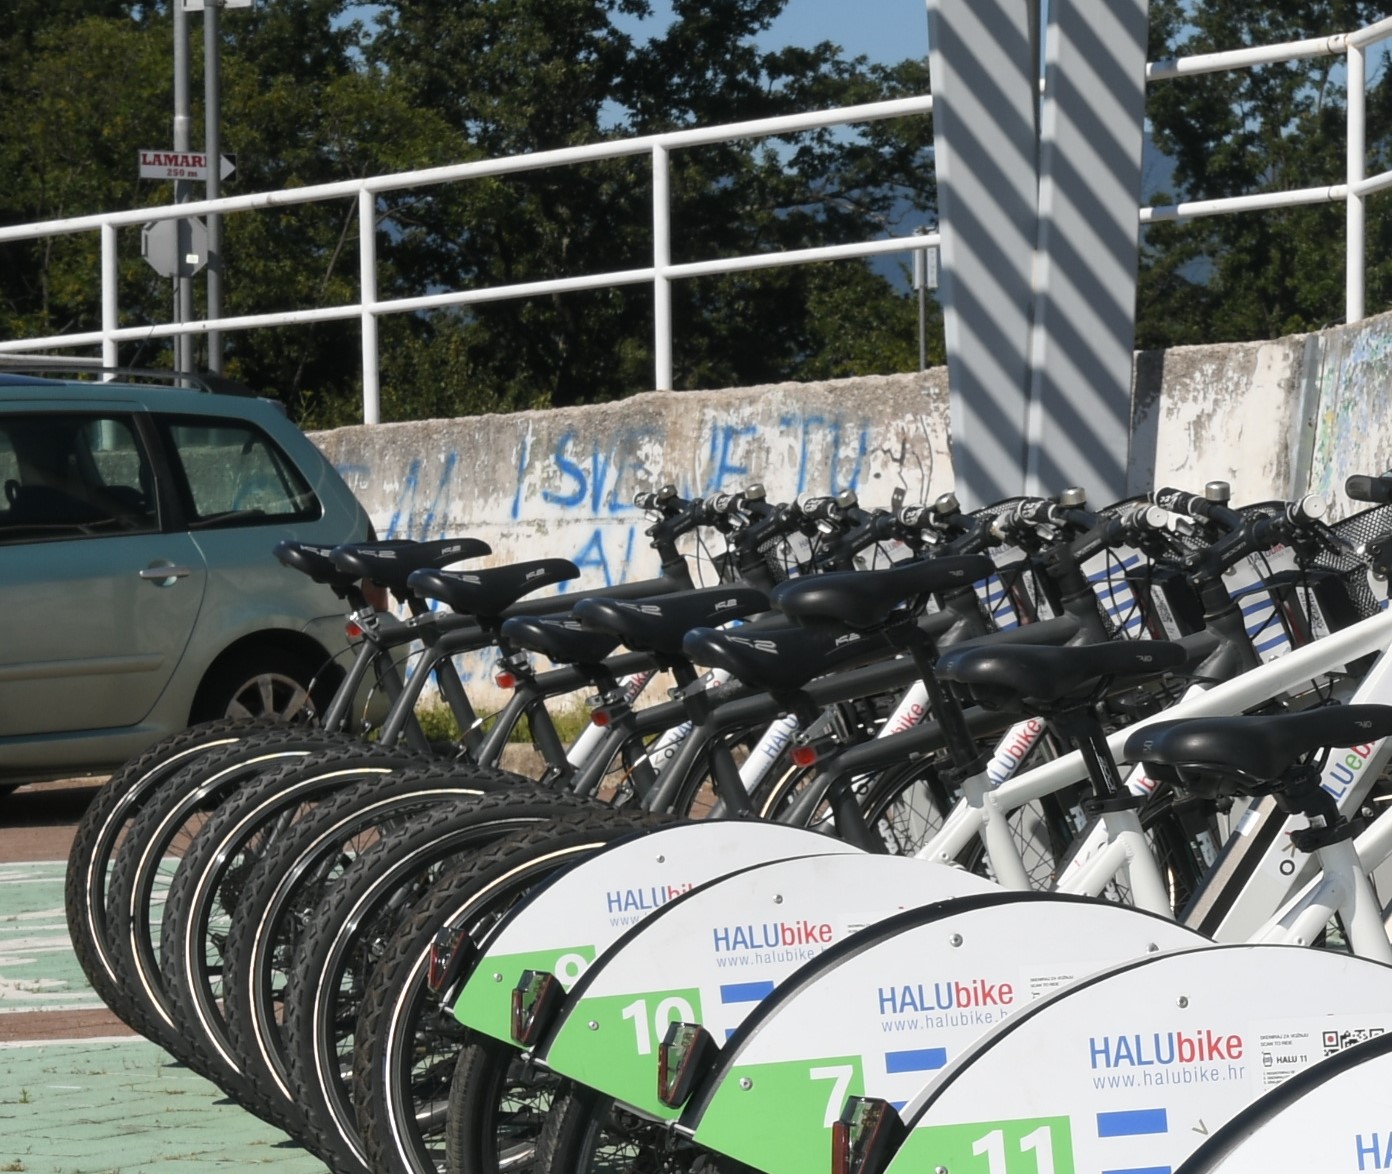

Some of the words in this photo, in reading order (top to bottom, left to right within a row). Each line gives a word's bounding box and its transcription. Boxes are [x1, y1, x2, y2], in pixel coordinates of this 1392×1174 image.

[713, 919, 833, 953] HALUbike
[554, 952, 590, 991] 9
[877, 980, 1014, 1015] HALUbike
[622, 996, 695, 1055] 10
[1089, 1029, 1244, 1069] HALUbike
[810, 1064, 854, 1128] 7
[1092, 1065, 1246, 1090] www.halubike.hr
